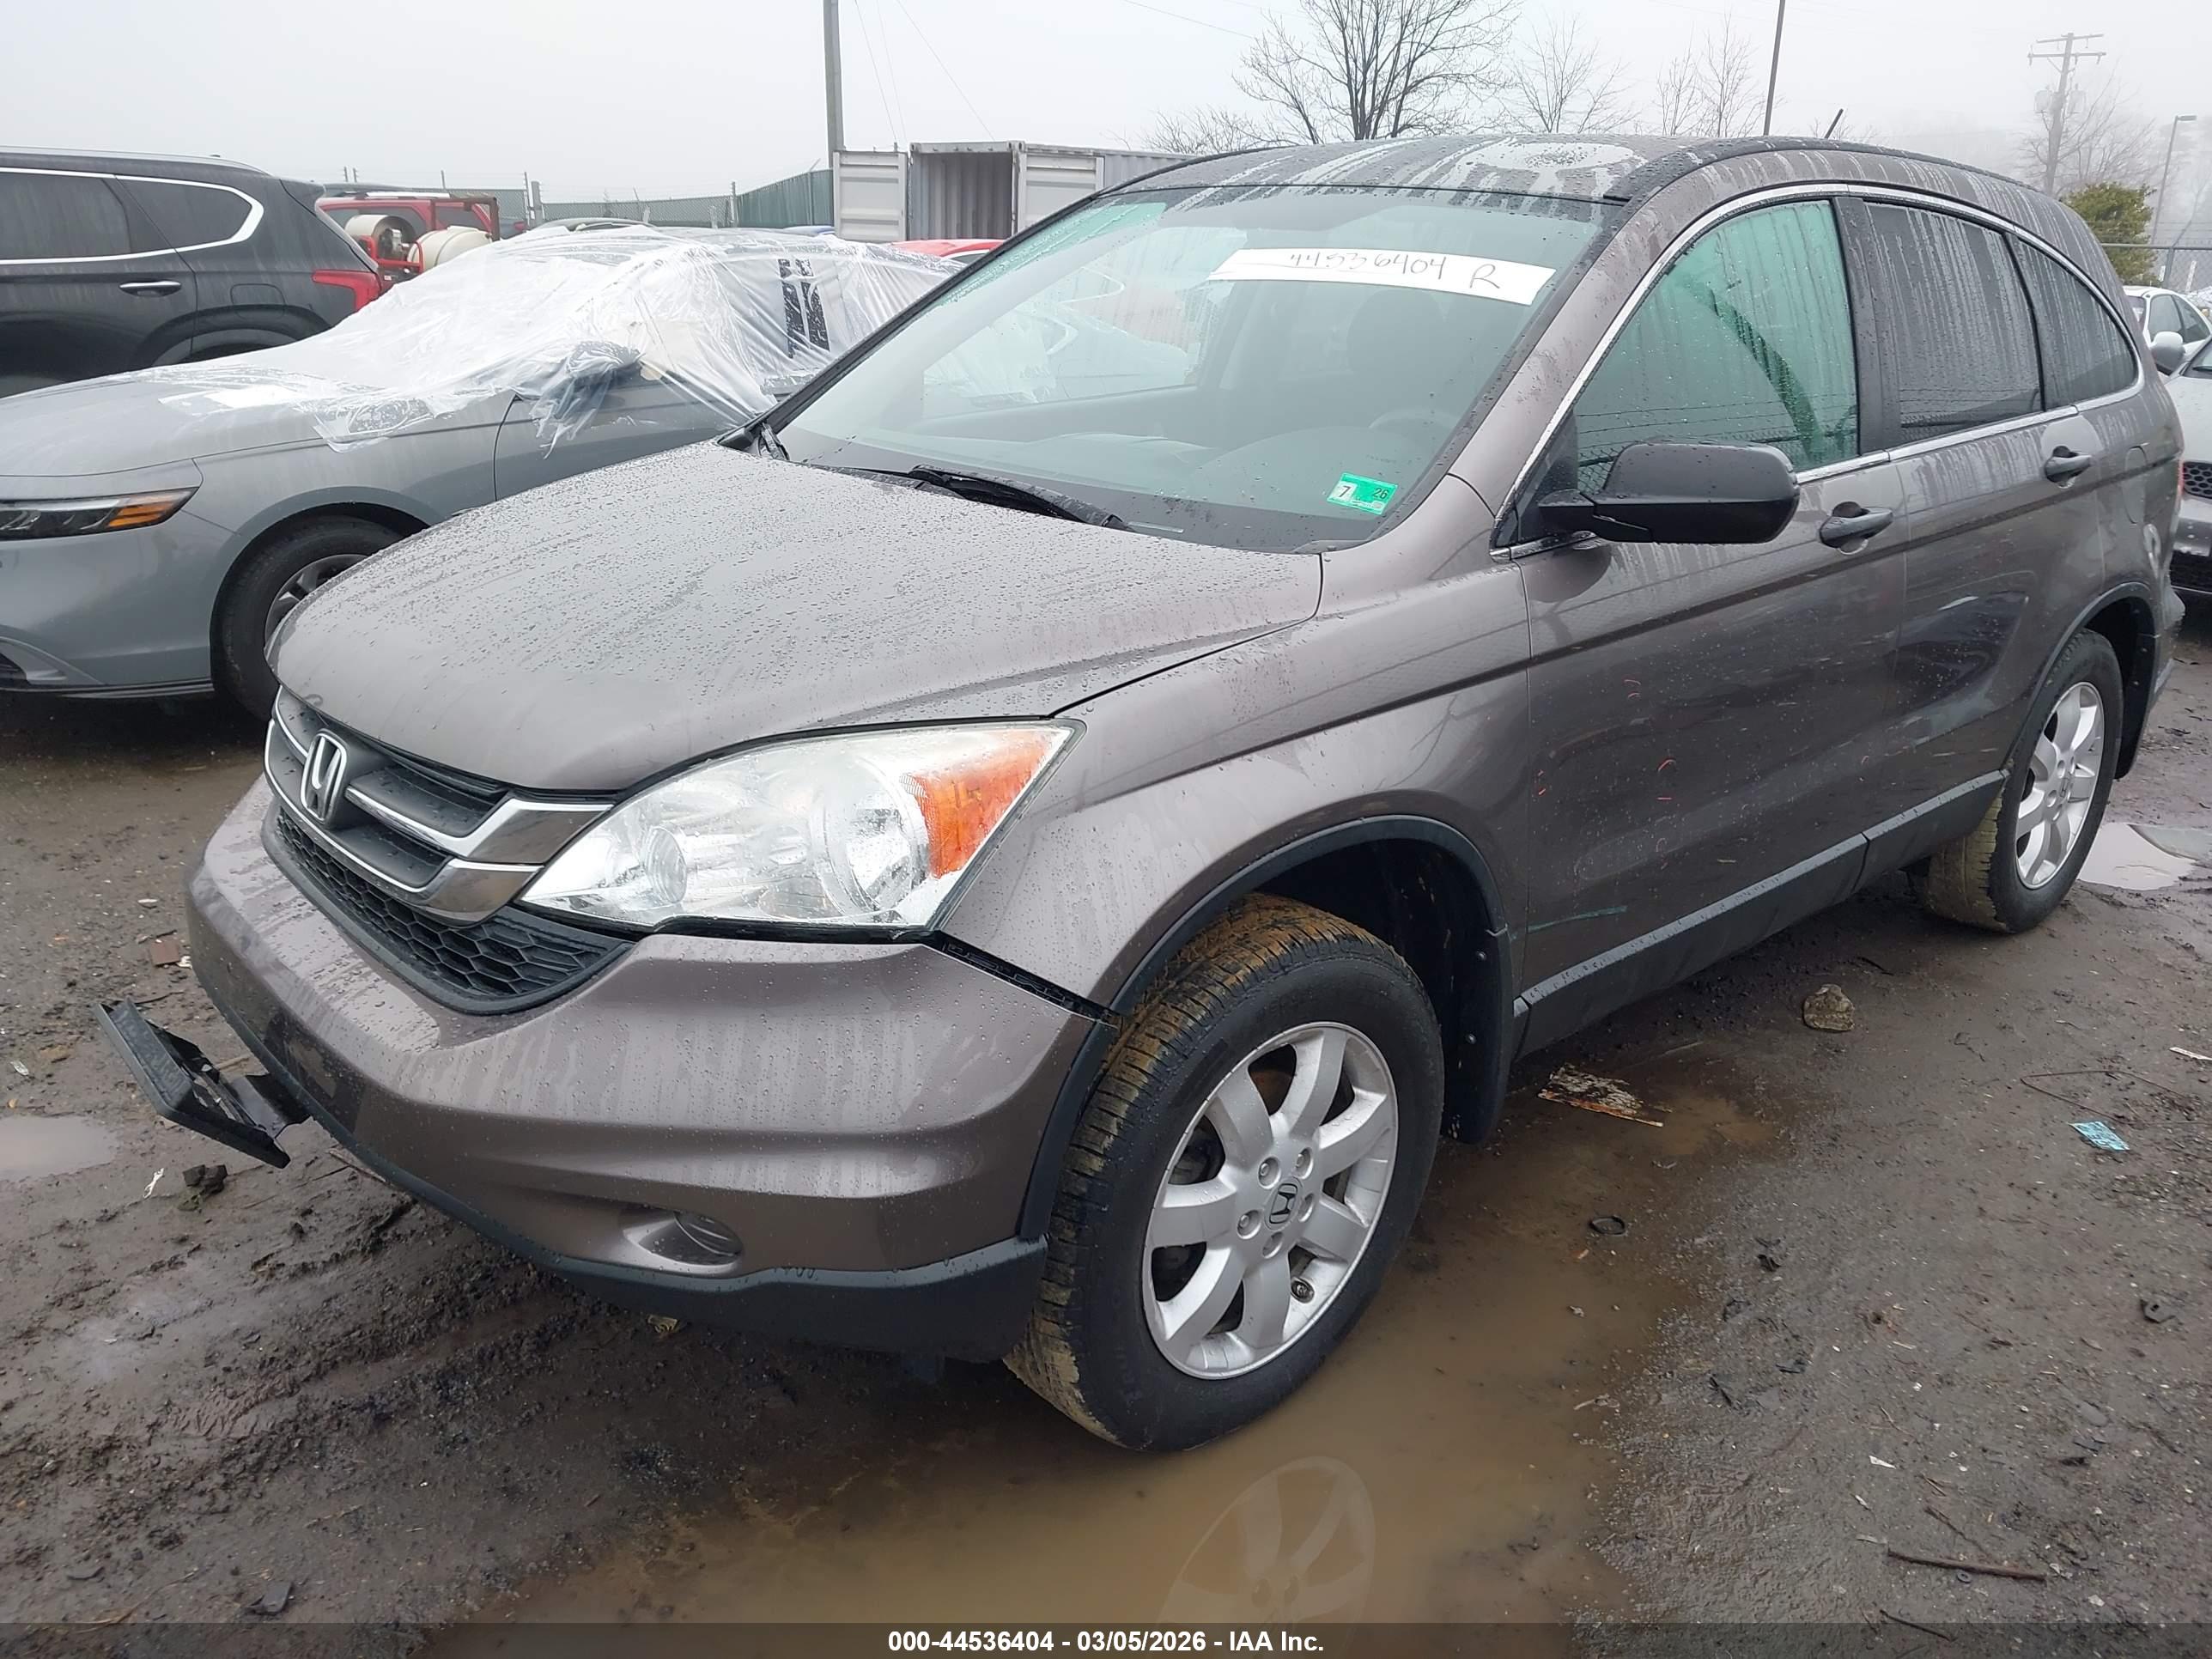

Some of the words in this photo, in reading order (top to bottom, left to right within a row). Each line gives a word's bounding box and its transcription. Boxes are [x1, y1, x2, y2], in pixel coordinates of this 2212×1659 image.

[1290, 252, 1447, 280] 44536404
[1469, 264, 1501, 289] R
[1339, 485, 1352, 498] 7
[1372, 487, 1389, 500] 26
